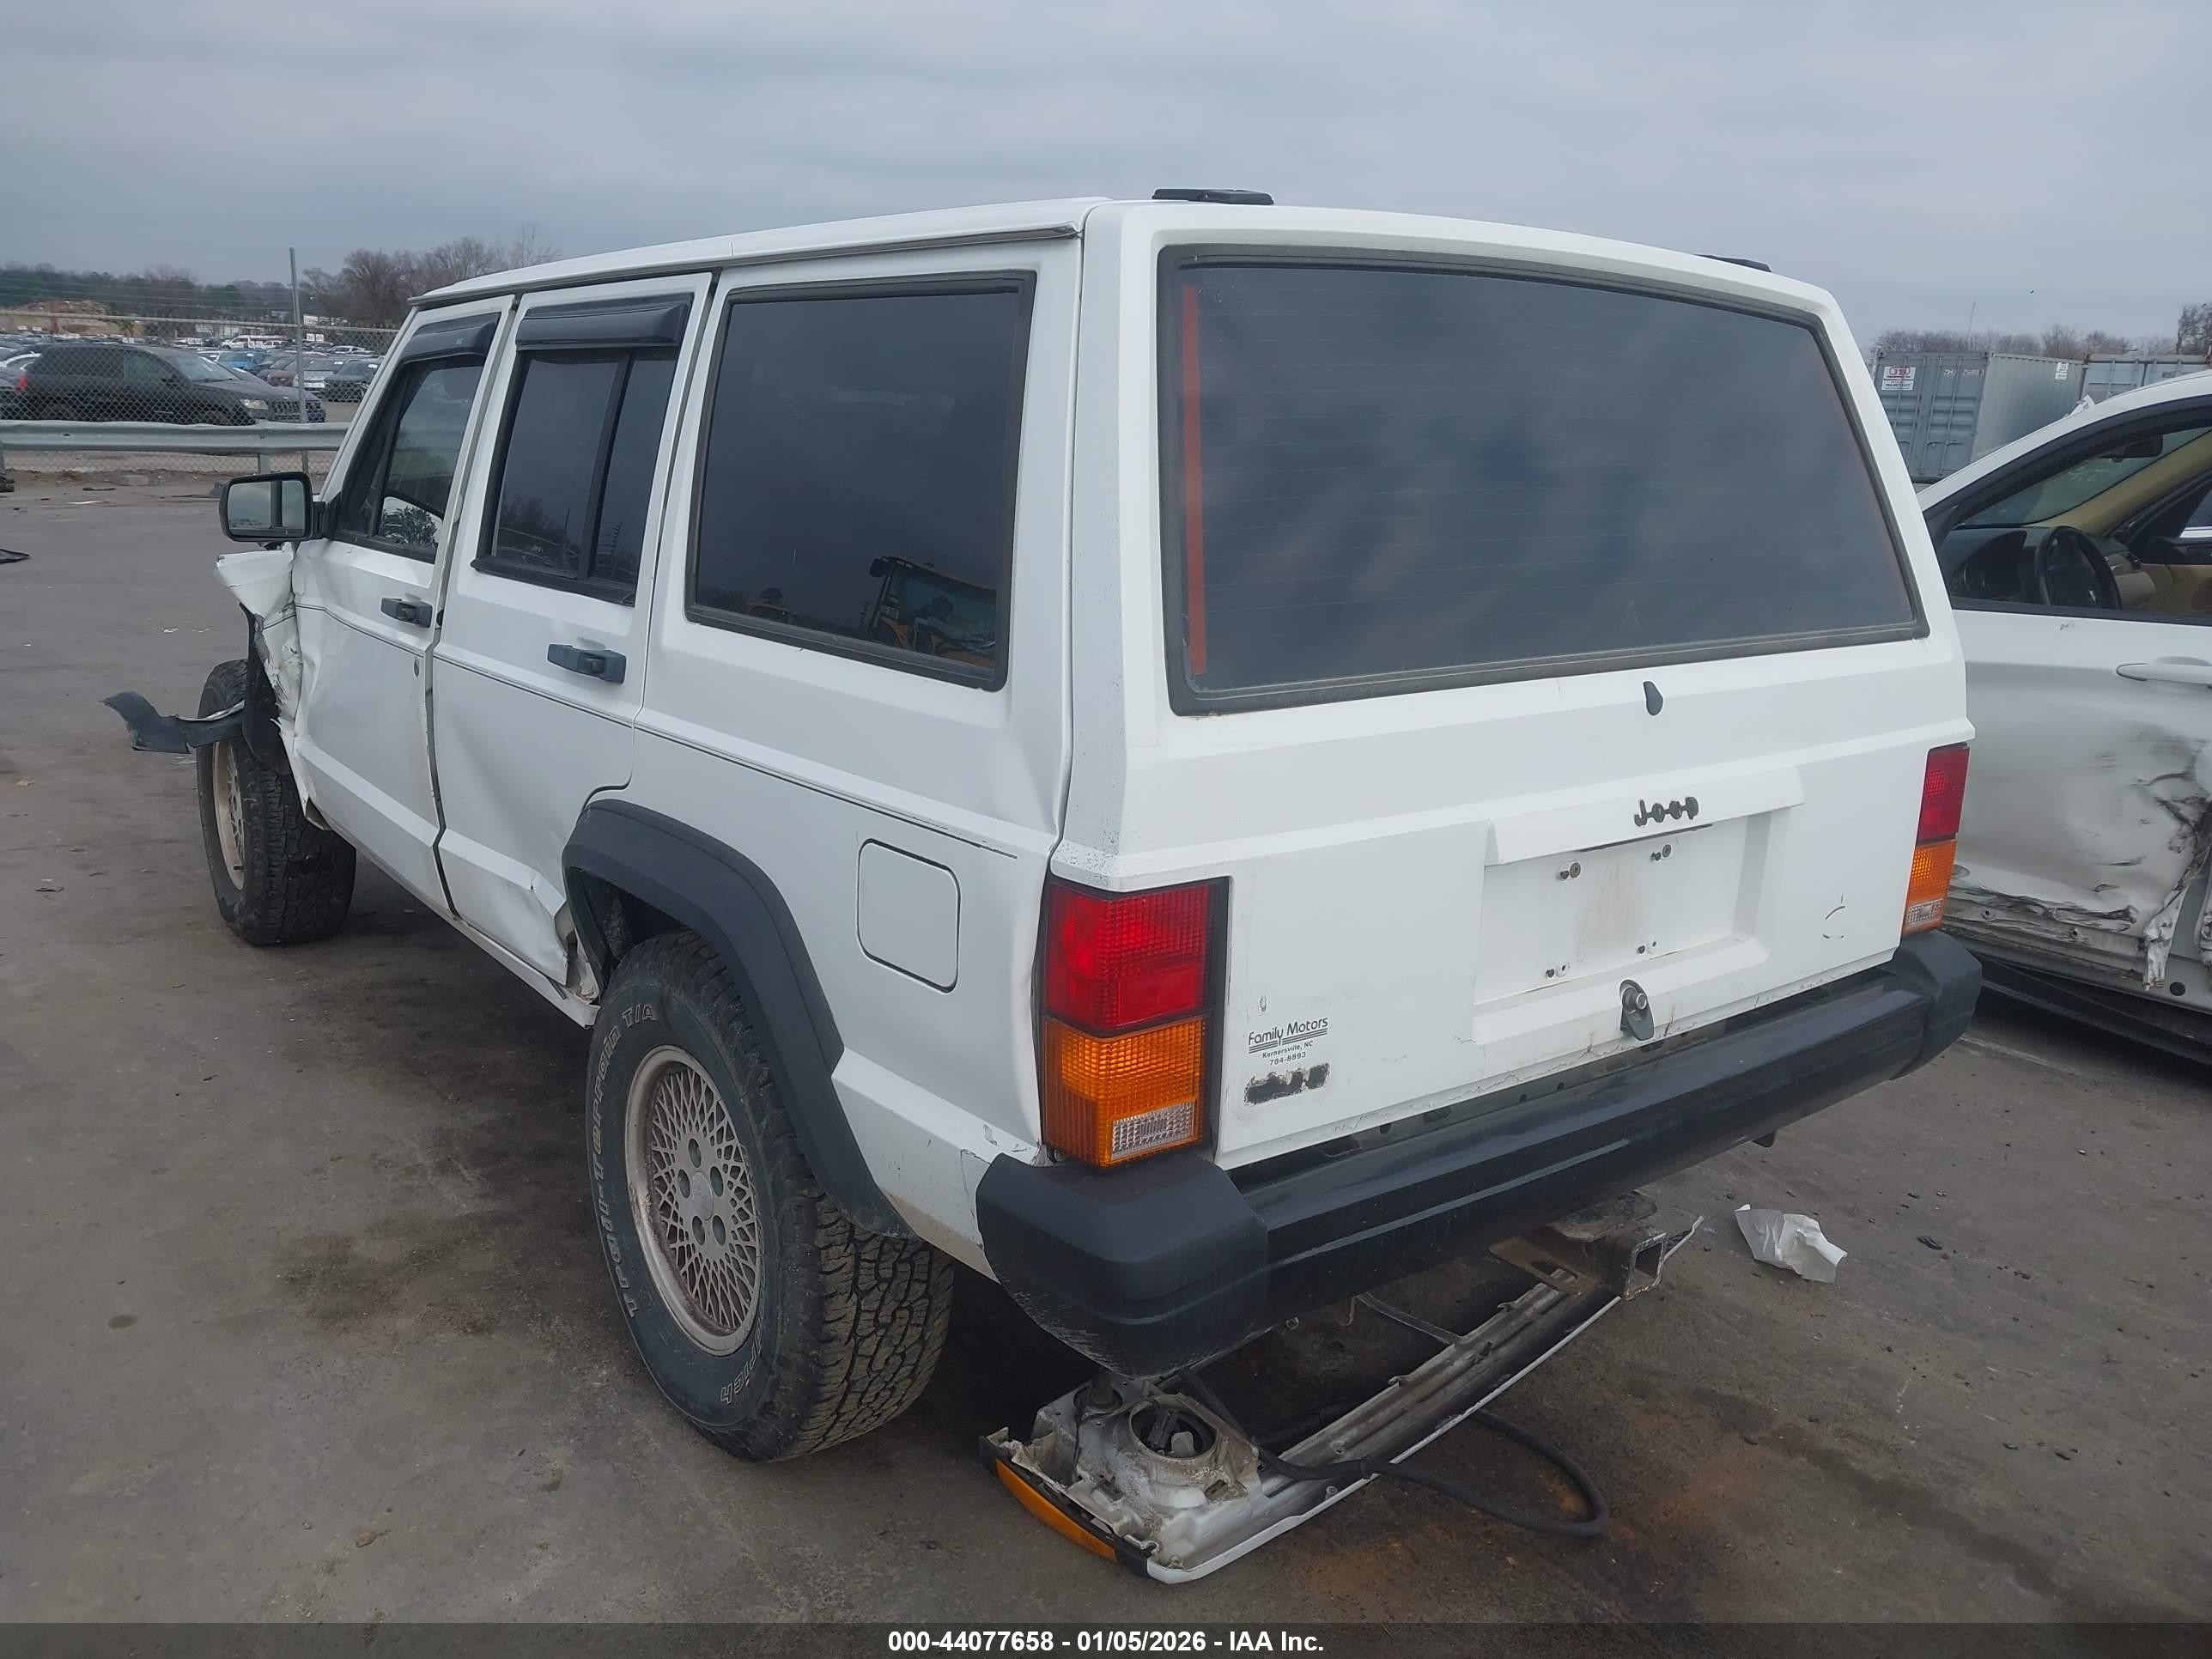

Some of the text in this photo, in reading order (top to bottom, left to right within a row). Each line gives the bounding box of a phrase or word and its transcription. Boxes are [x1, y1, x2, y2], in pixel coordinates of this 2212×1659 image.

[622, 1004, 659, 1028] T/A
[1248, 1017, 1329, 1046] Family Motors
[1304, 1040, 1314, 1048] NC
